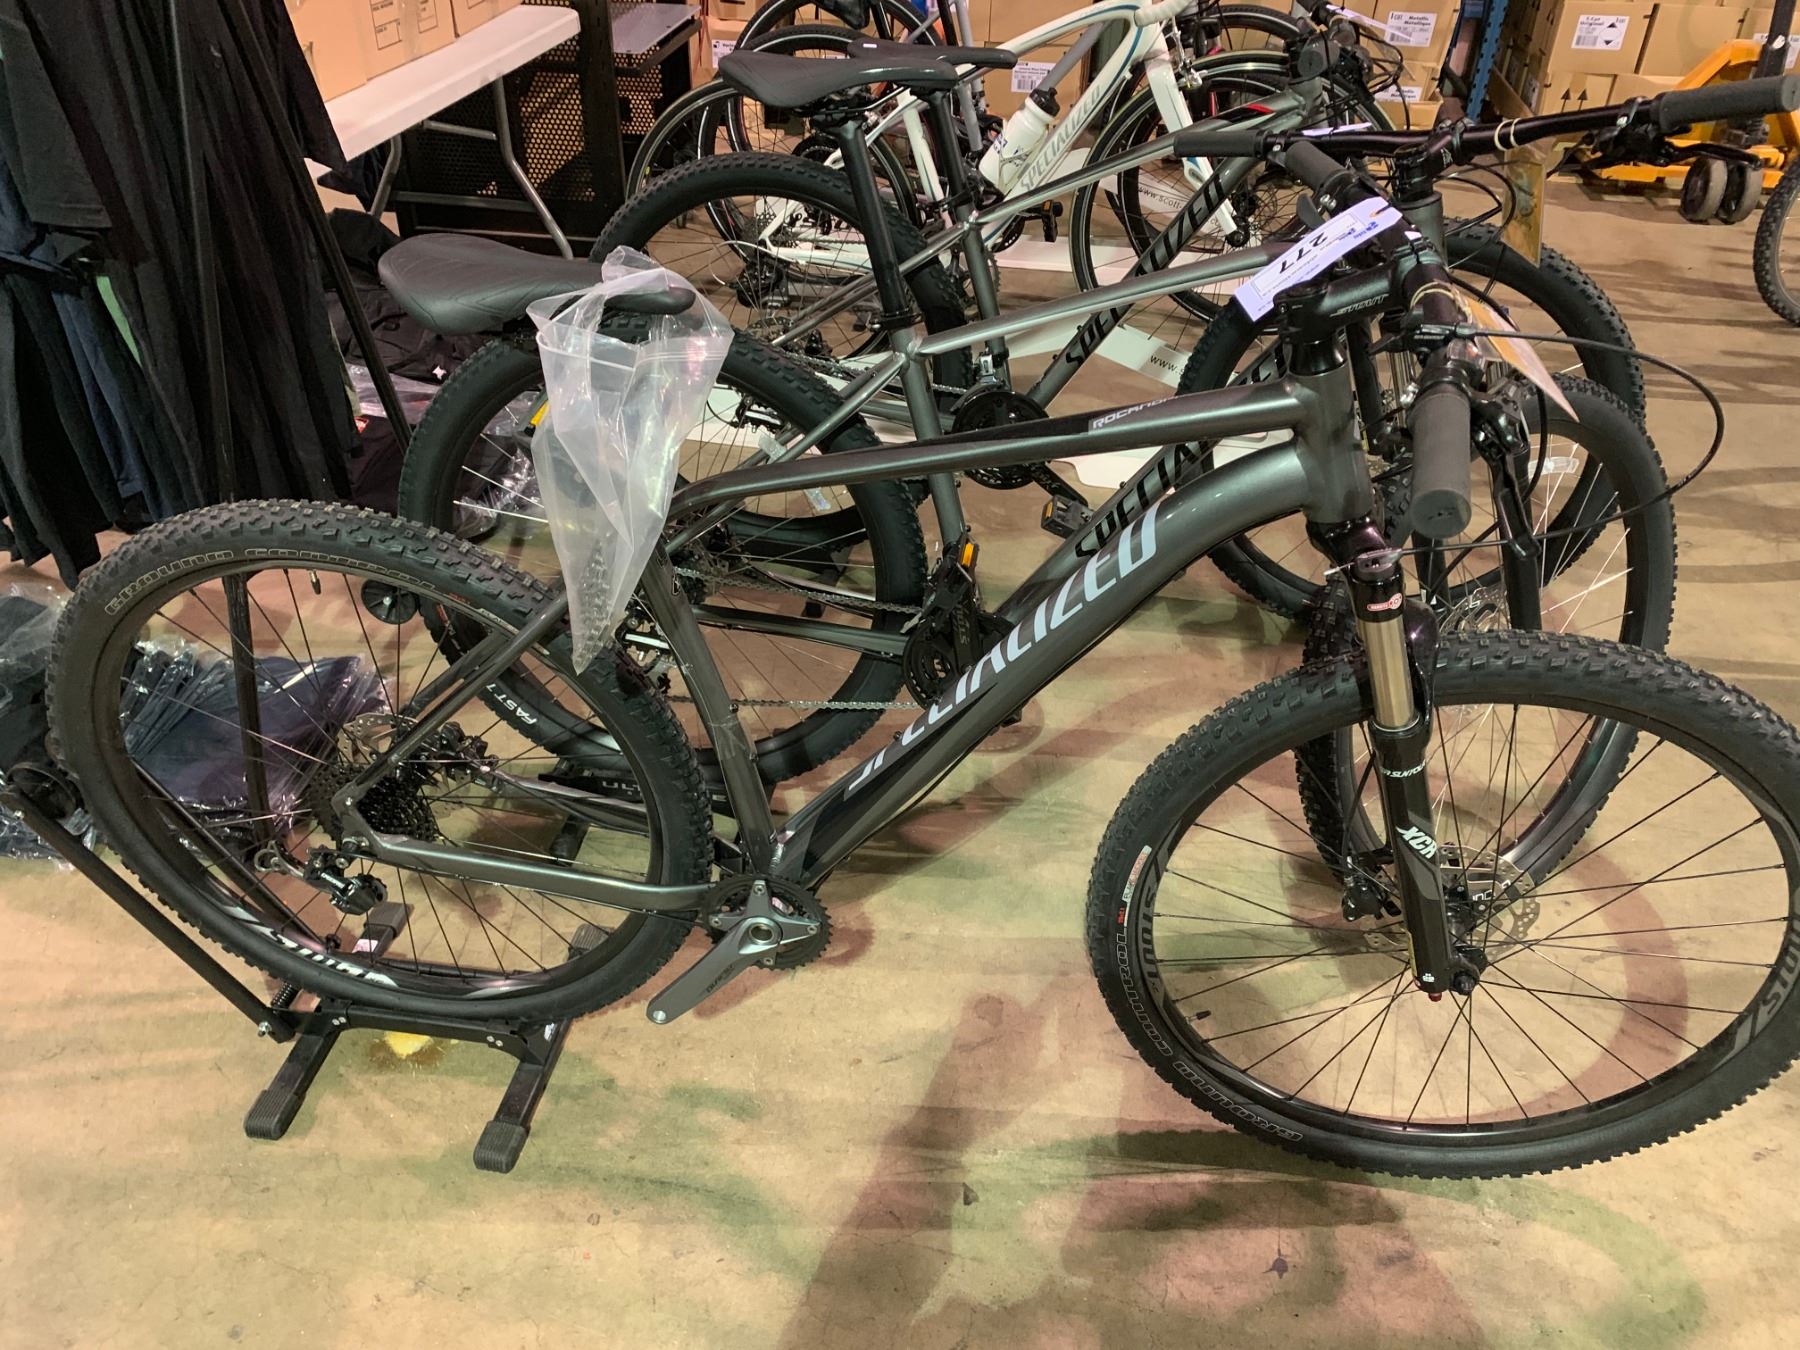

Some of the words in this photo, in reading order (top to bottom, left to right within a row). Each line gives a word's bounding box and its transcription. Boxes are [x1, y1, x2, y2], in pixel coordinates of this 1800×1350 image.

[1021, 85, 1101, 191] SPECIALIZED
[1279, 231, 1328, 274] 277
[104, 550, 233, 615] GROUND
[494, 693, 538, 726] FAST
[1396, 826, 1437, 859] XCR
[1116, 933, 1174, 1057] CONTROL
[1172, 1060, 1304, 1142] GROUND
